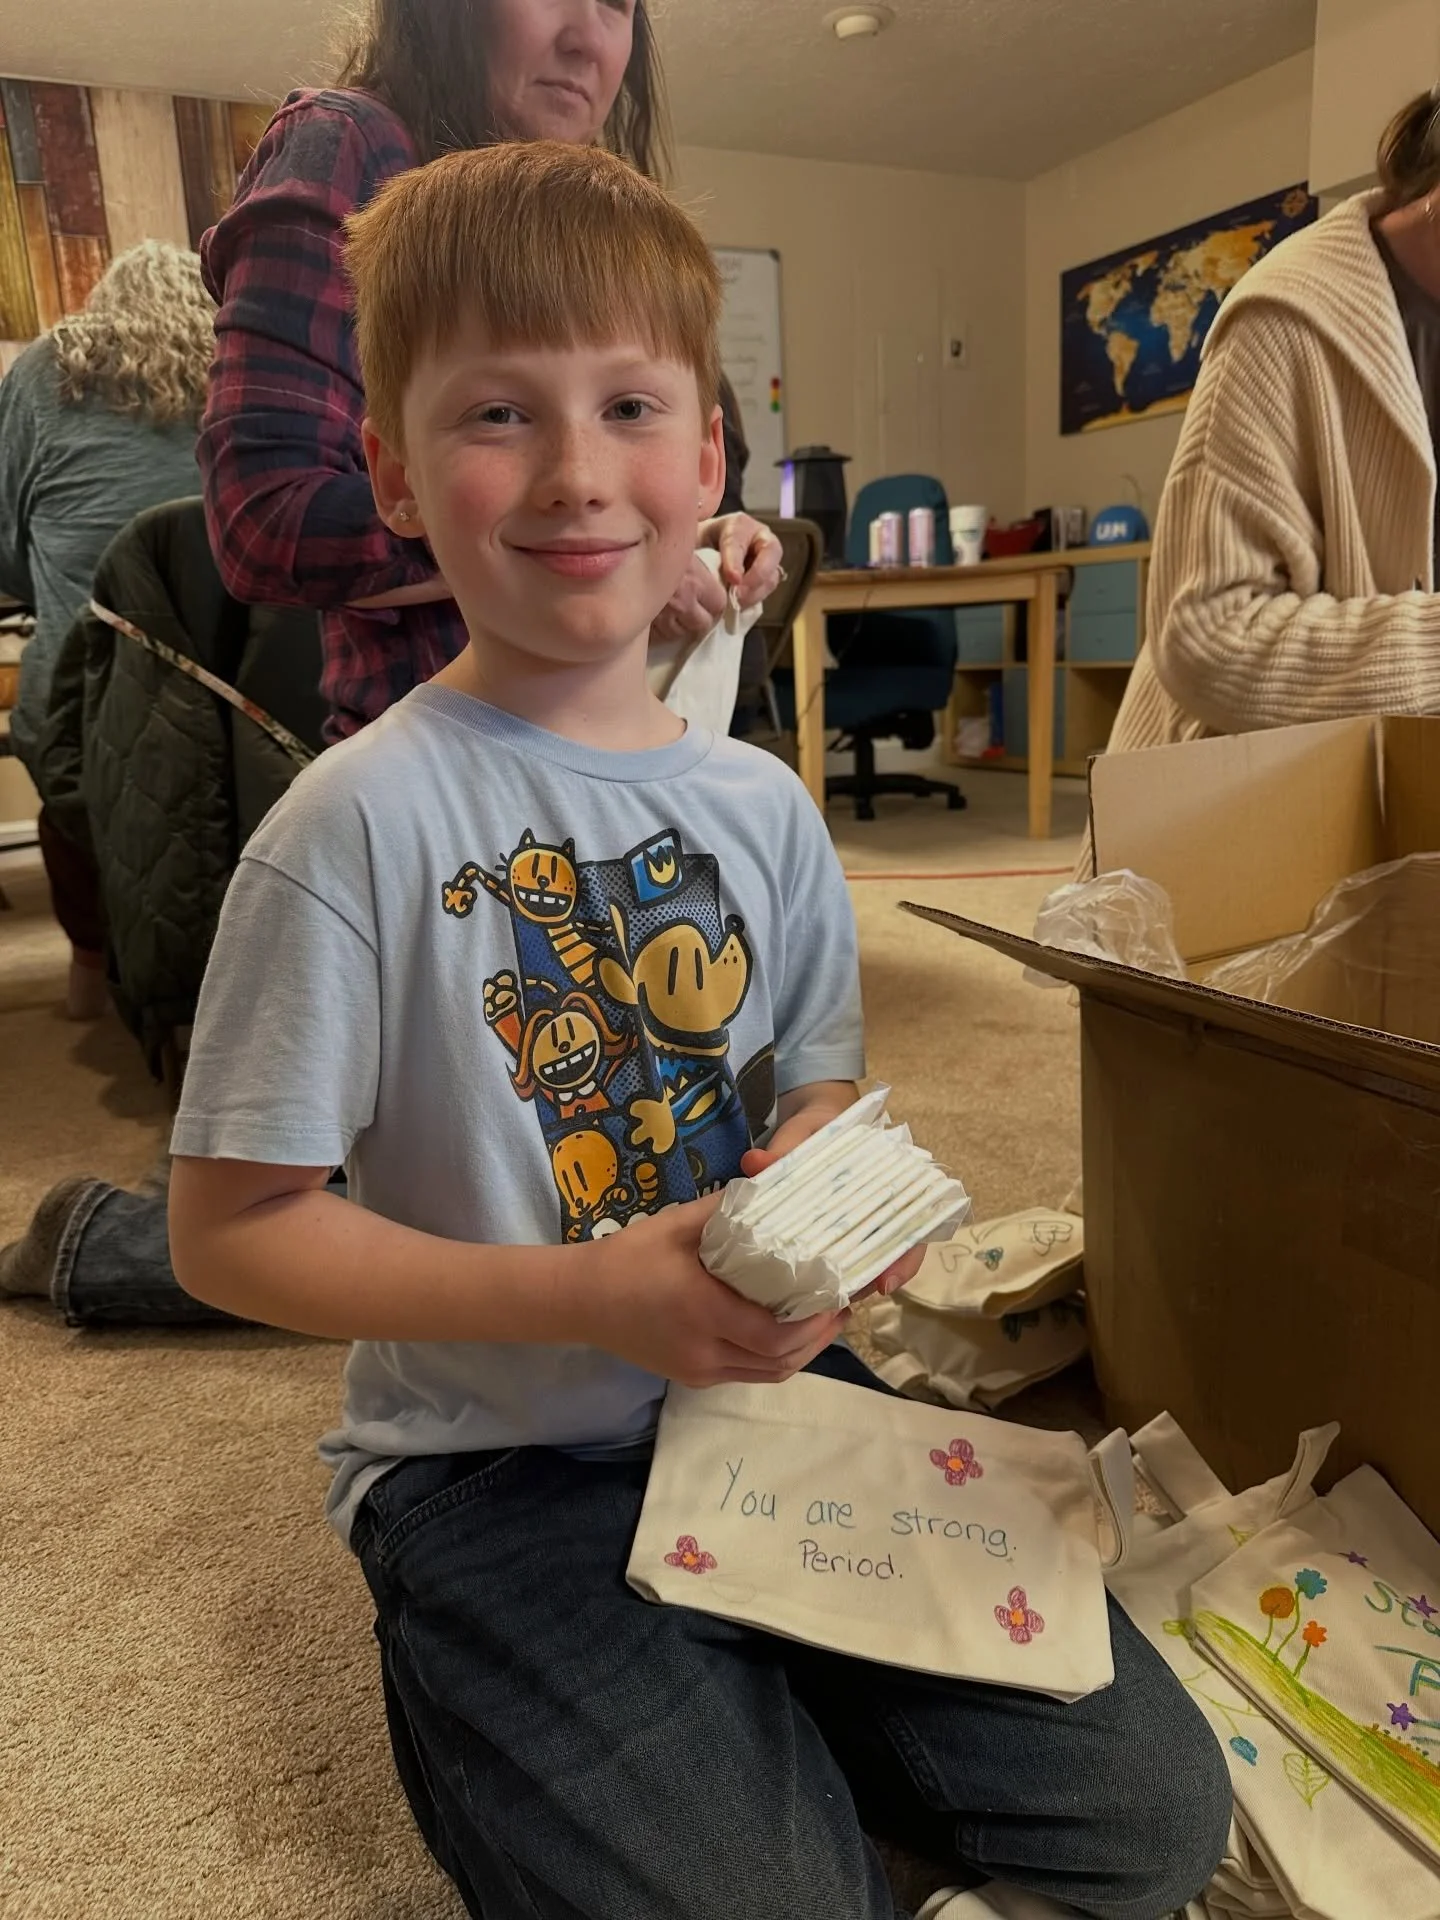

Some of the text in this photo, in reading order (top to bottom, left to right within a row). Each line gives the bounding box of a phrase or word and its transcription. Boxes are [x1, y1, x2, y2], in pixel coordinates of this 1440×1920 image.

[719, 1456, 1018, 1557] You are strong.
[799, 1539, 904, 1580] Period.
